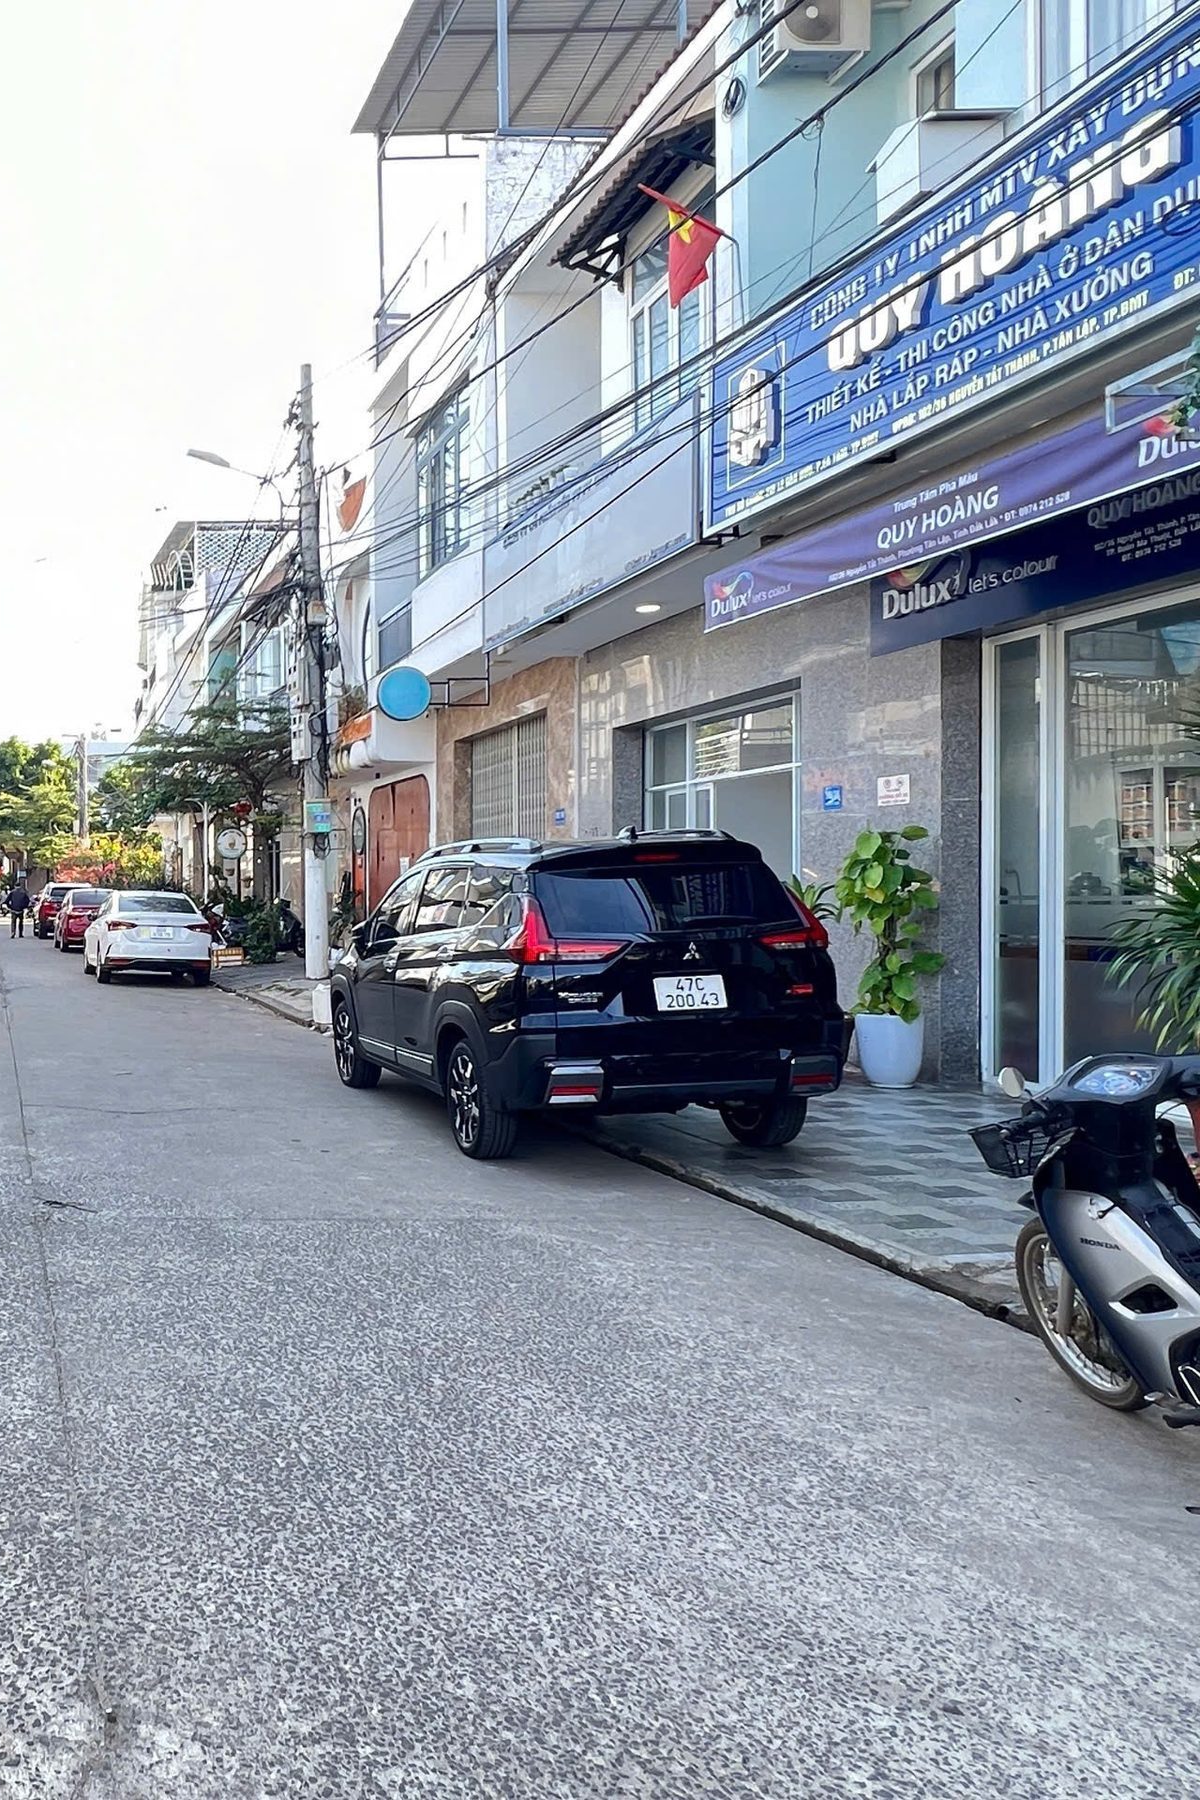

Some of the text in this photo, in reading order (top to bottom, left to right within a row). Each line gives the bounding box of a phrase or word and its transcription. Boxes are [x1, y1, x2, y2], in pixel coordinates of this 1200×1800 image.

[828, 108, 1181, 372] QUY HOÀNG
[806, 379, 852, 424] THIẾT
[857, 357, 884, 397] KẾ
[898, 339, 929, 372] THI
[933, 301, 995, 352] CÔNG
[1001, 264, 1053, 314] NHÀ
[1084, 211, 1145, 266] DÂN
[1103, 290, 1149, 326] TP.BMT
[850, 394, 889, 433] NHÀ
[935, 347, 978, 388] RÁP
[997, 305, 1049, 354] NHÀ
[1054, 251, 1154, 324] XƯỞNG
[876, 485, 999, 549] QUY HOÀNG
[1004, 509, 1018, 523] ĐT:
[1039, 497, 1054, 511] 212
[1088, 499, 1128, 528] QUY
[711, 593, 747, 617] Dulux
[882, 577, 952, 620] Dulux
[665, 992, 720, 1009] 200.43
[675, 977, 705, 992] 47C
[1080, 1237, 1121, 1251] HONDA
